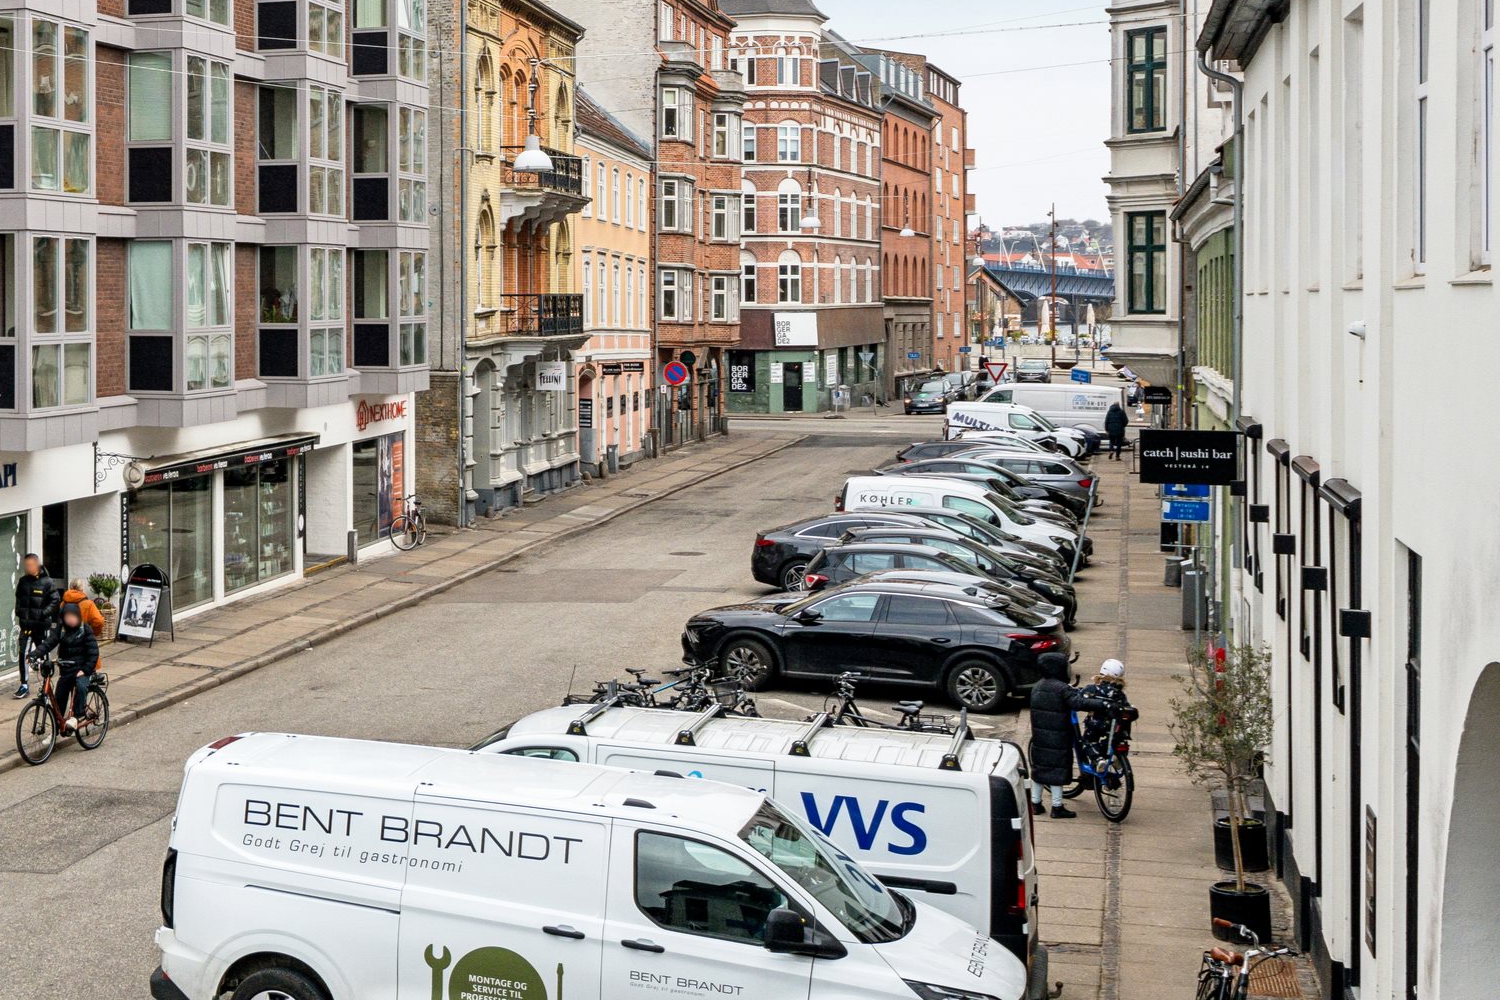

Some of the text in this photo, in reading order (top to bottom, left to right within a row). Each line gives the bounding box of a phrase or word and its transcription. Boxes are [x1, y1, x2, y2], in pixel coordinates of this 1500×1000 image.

[369, 400, 407, 422] NEXTHOME
[1143, 447, 1174, 458] catch
[1180, 448, 1209, 459] sushi
[1212, 449, 1233, 460] bar
[860, 494, 913, 505] KØHLER
[244, 799, 583, 864] BENT BRANDT
[800, 791, 928, 856] VVS
[242, 833, 464, 874] Godt Grej til gastronomi
[468, 974, 528, 991] MONTAGE OG
[472, 984, 524, 1000] SERVICE TIL
[629, 970, 744, 996] BENT BRANDT
